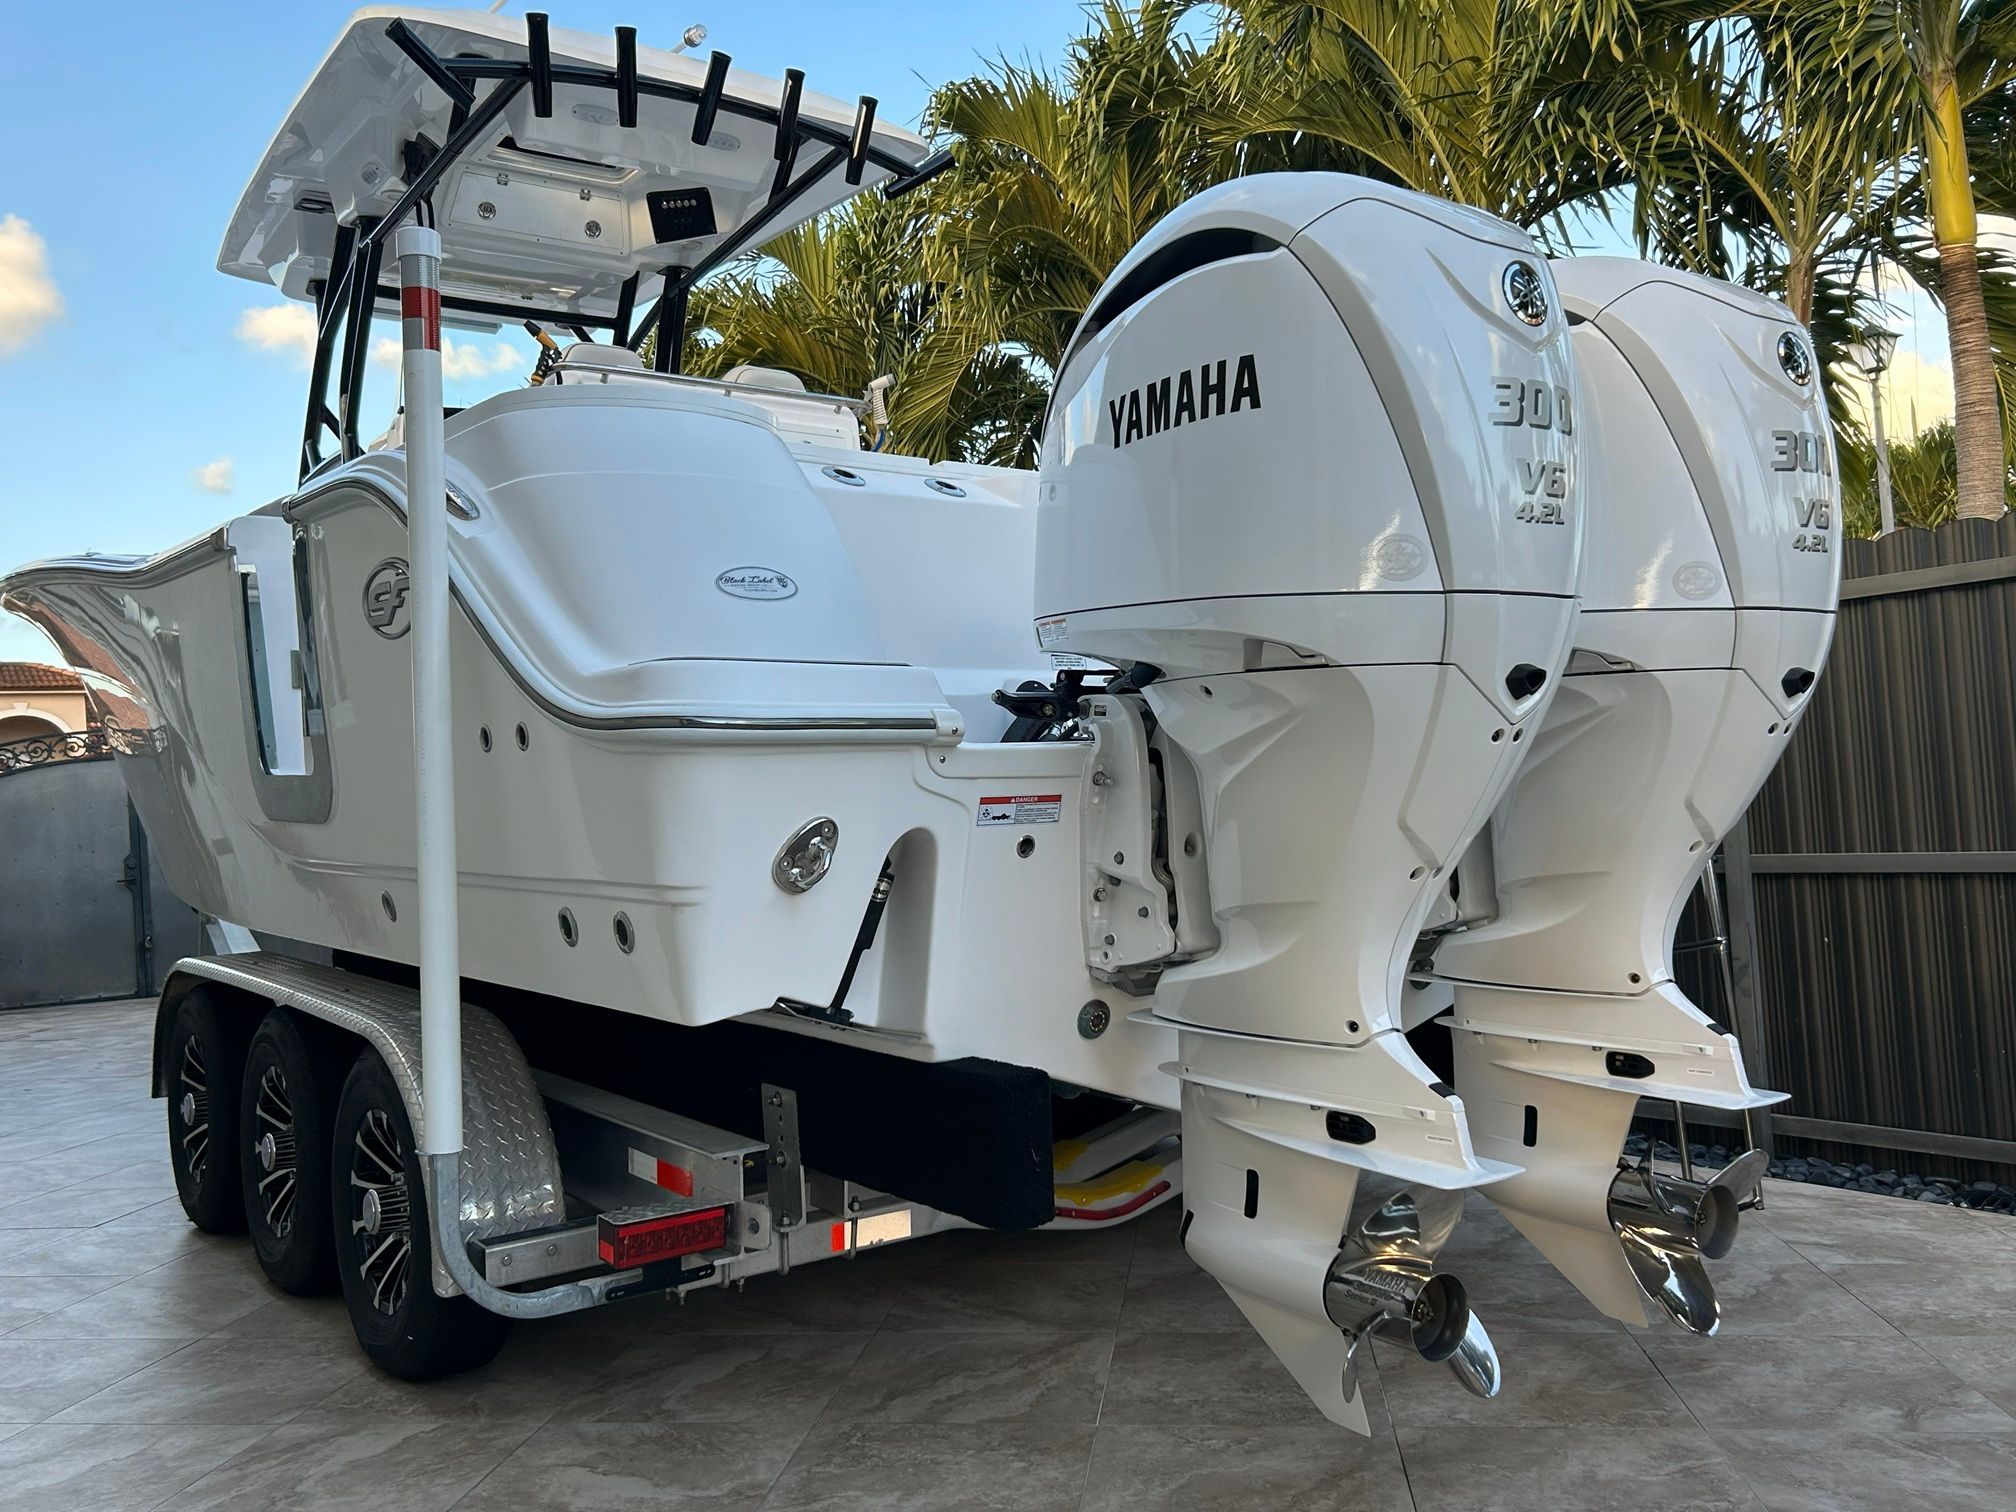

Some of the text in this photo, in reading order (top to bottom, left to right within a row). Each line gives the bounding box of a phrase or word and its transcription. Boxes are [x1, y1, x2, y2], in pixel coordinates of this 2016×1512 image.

[1109, 354, 1262, 450] YAMAHA
[1488, 376, 1572, 436] 300
[1516, 457, 1566, 499] V6
[1514, 501, 1565, 525] 4.2L
[1793, 497, 1830, 530] V6
[1792, 534, 1828, 553] 4.2L
[720, 575, 774, 585] Black Label
[1364, 1267, 1409, 1294] YAMAHA
